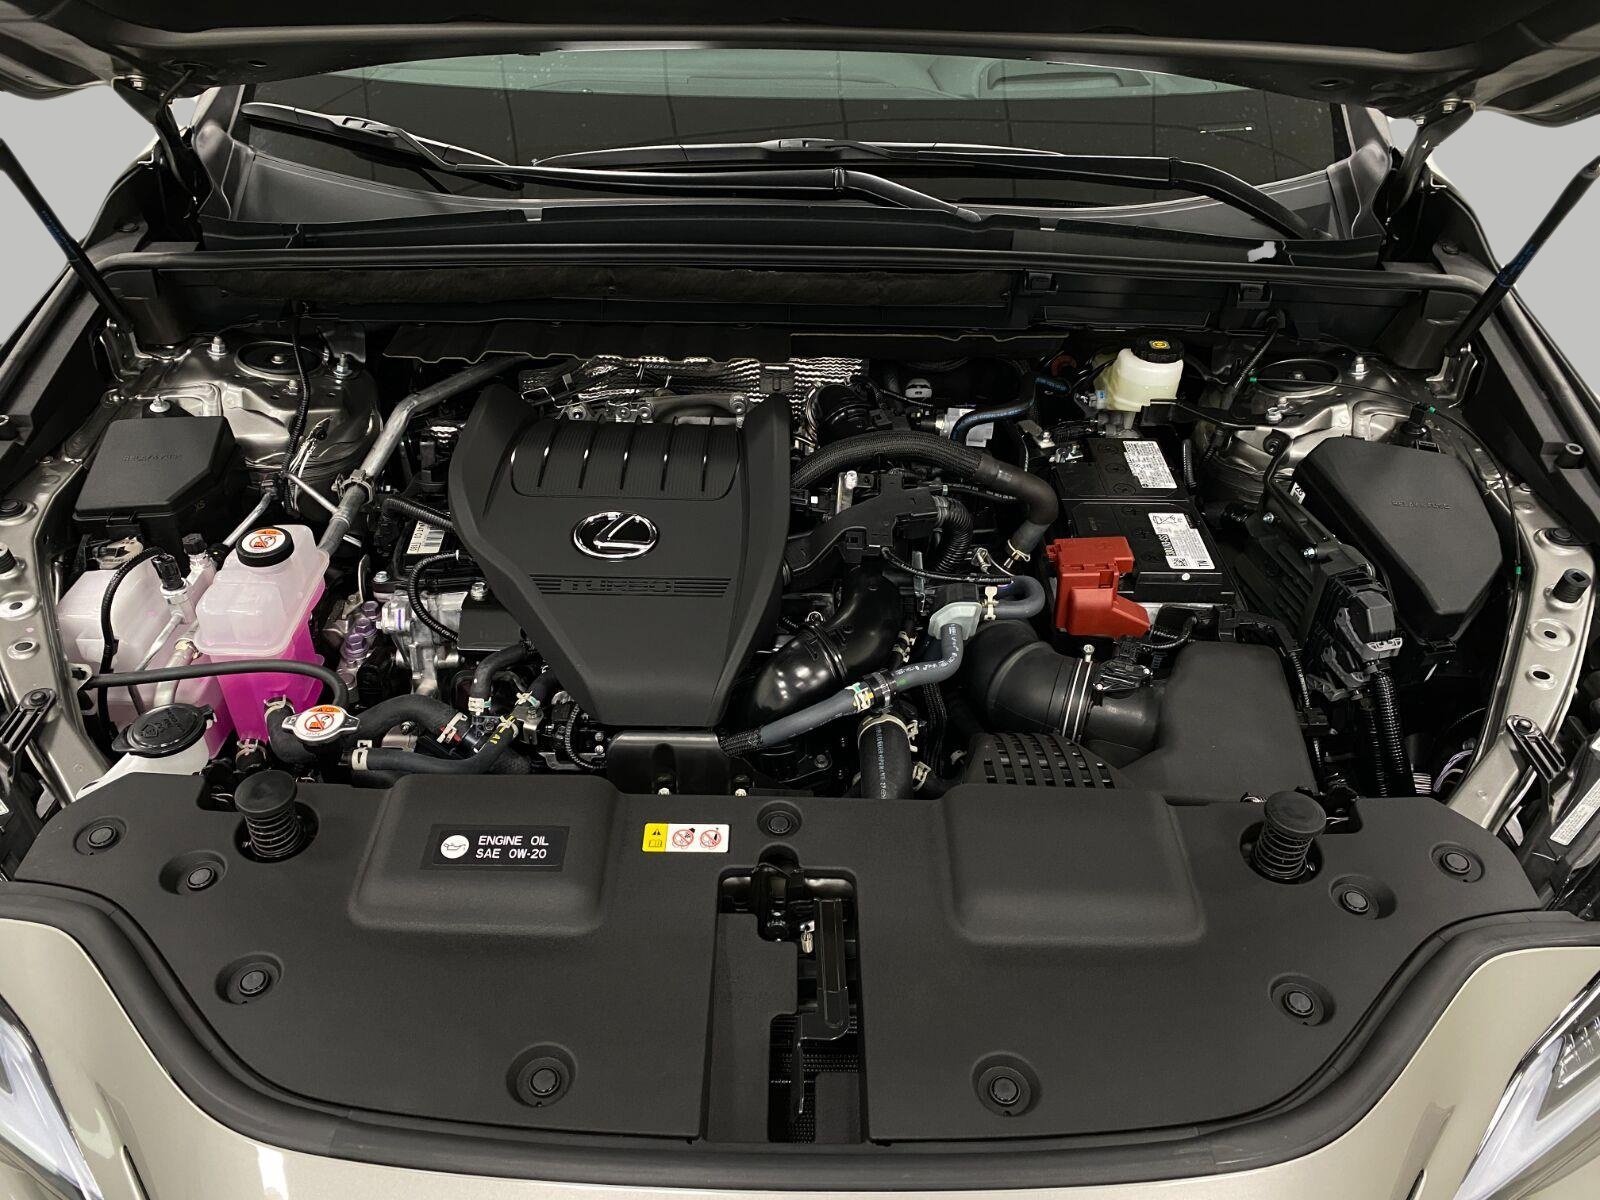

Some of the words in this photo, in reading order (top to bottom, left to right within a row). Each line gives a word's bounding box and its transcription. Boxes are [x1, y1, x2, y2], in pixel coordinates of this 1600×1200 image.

[561, 579, 672, 593] TURBO
[478, 835, 523, 846] ENGINE
[530, 835, 549, 846] OIL
[476, 848, 502, 859] SAE
[509, 848, 547, 859] 0W-20
